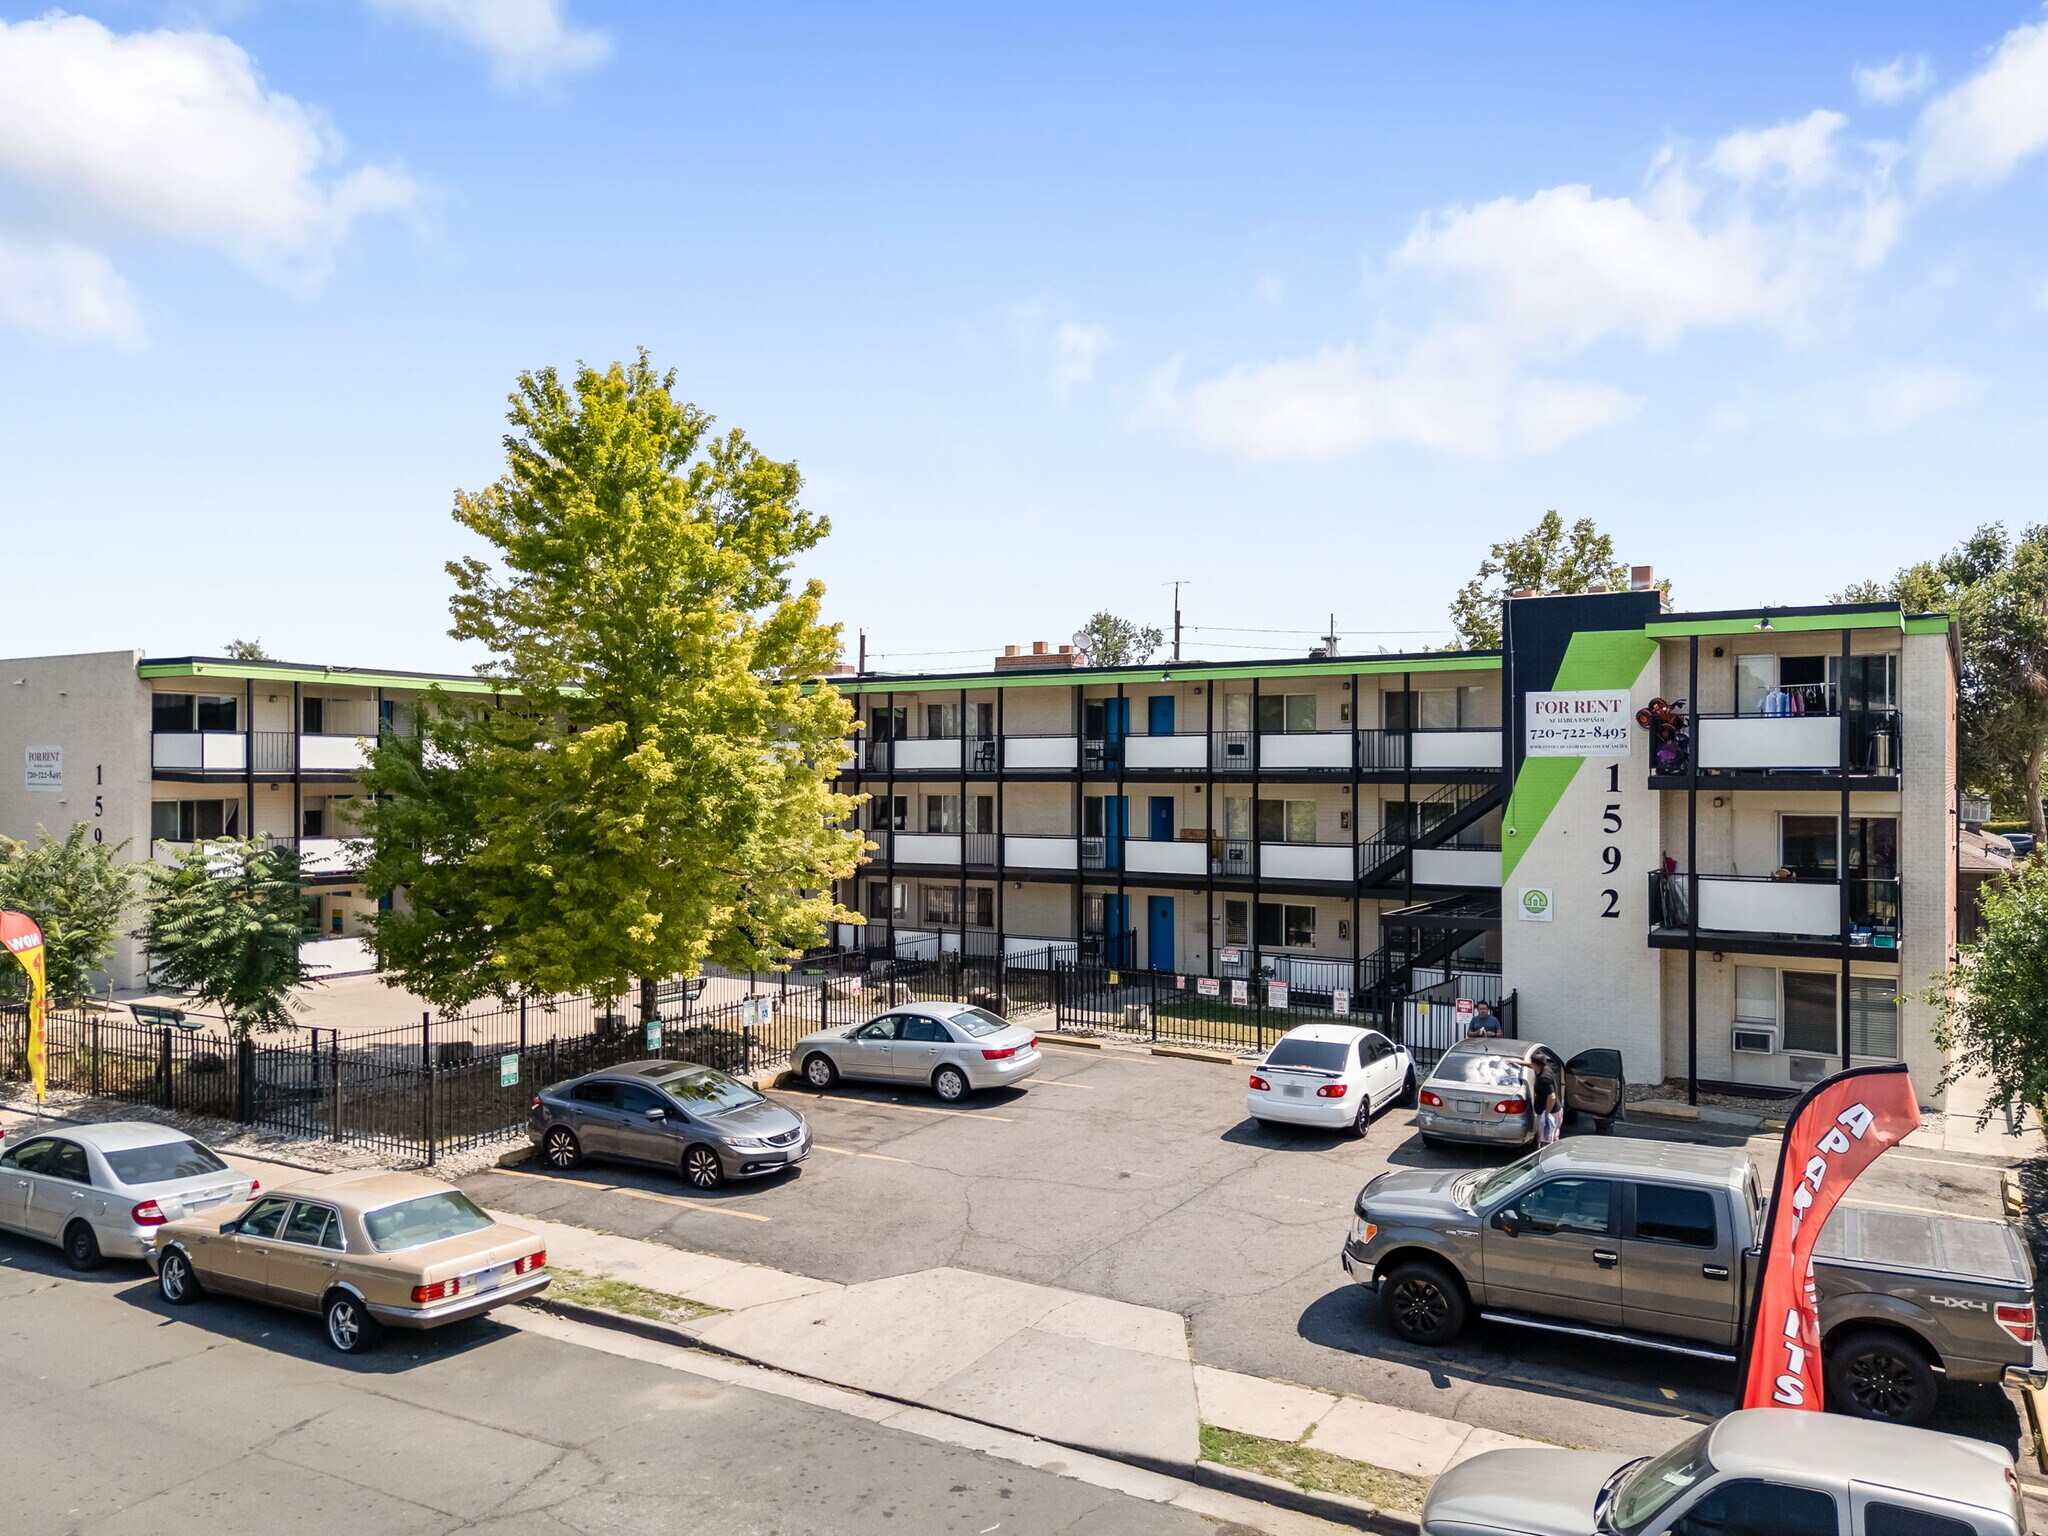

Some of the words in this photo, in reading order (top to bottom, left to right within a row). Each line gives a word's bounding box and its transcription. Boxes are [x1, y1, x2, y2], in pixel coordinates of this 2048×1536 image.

[1535, 700, 1569, 714] FOR
[1574, 699, 1622, 713] RENT
[1530, 725, 1627, 740] 720-722-8495
[28, 752, 42, 761] FOR
[42, 752, 60, 761] RENT
